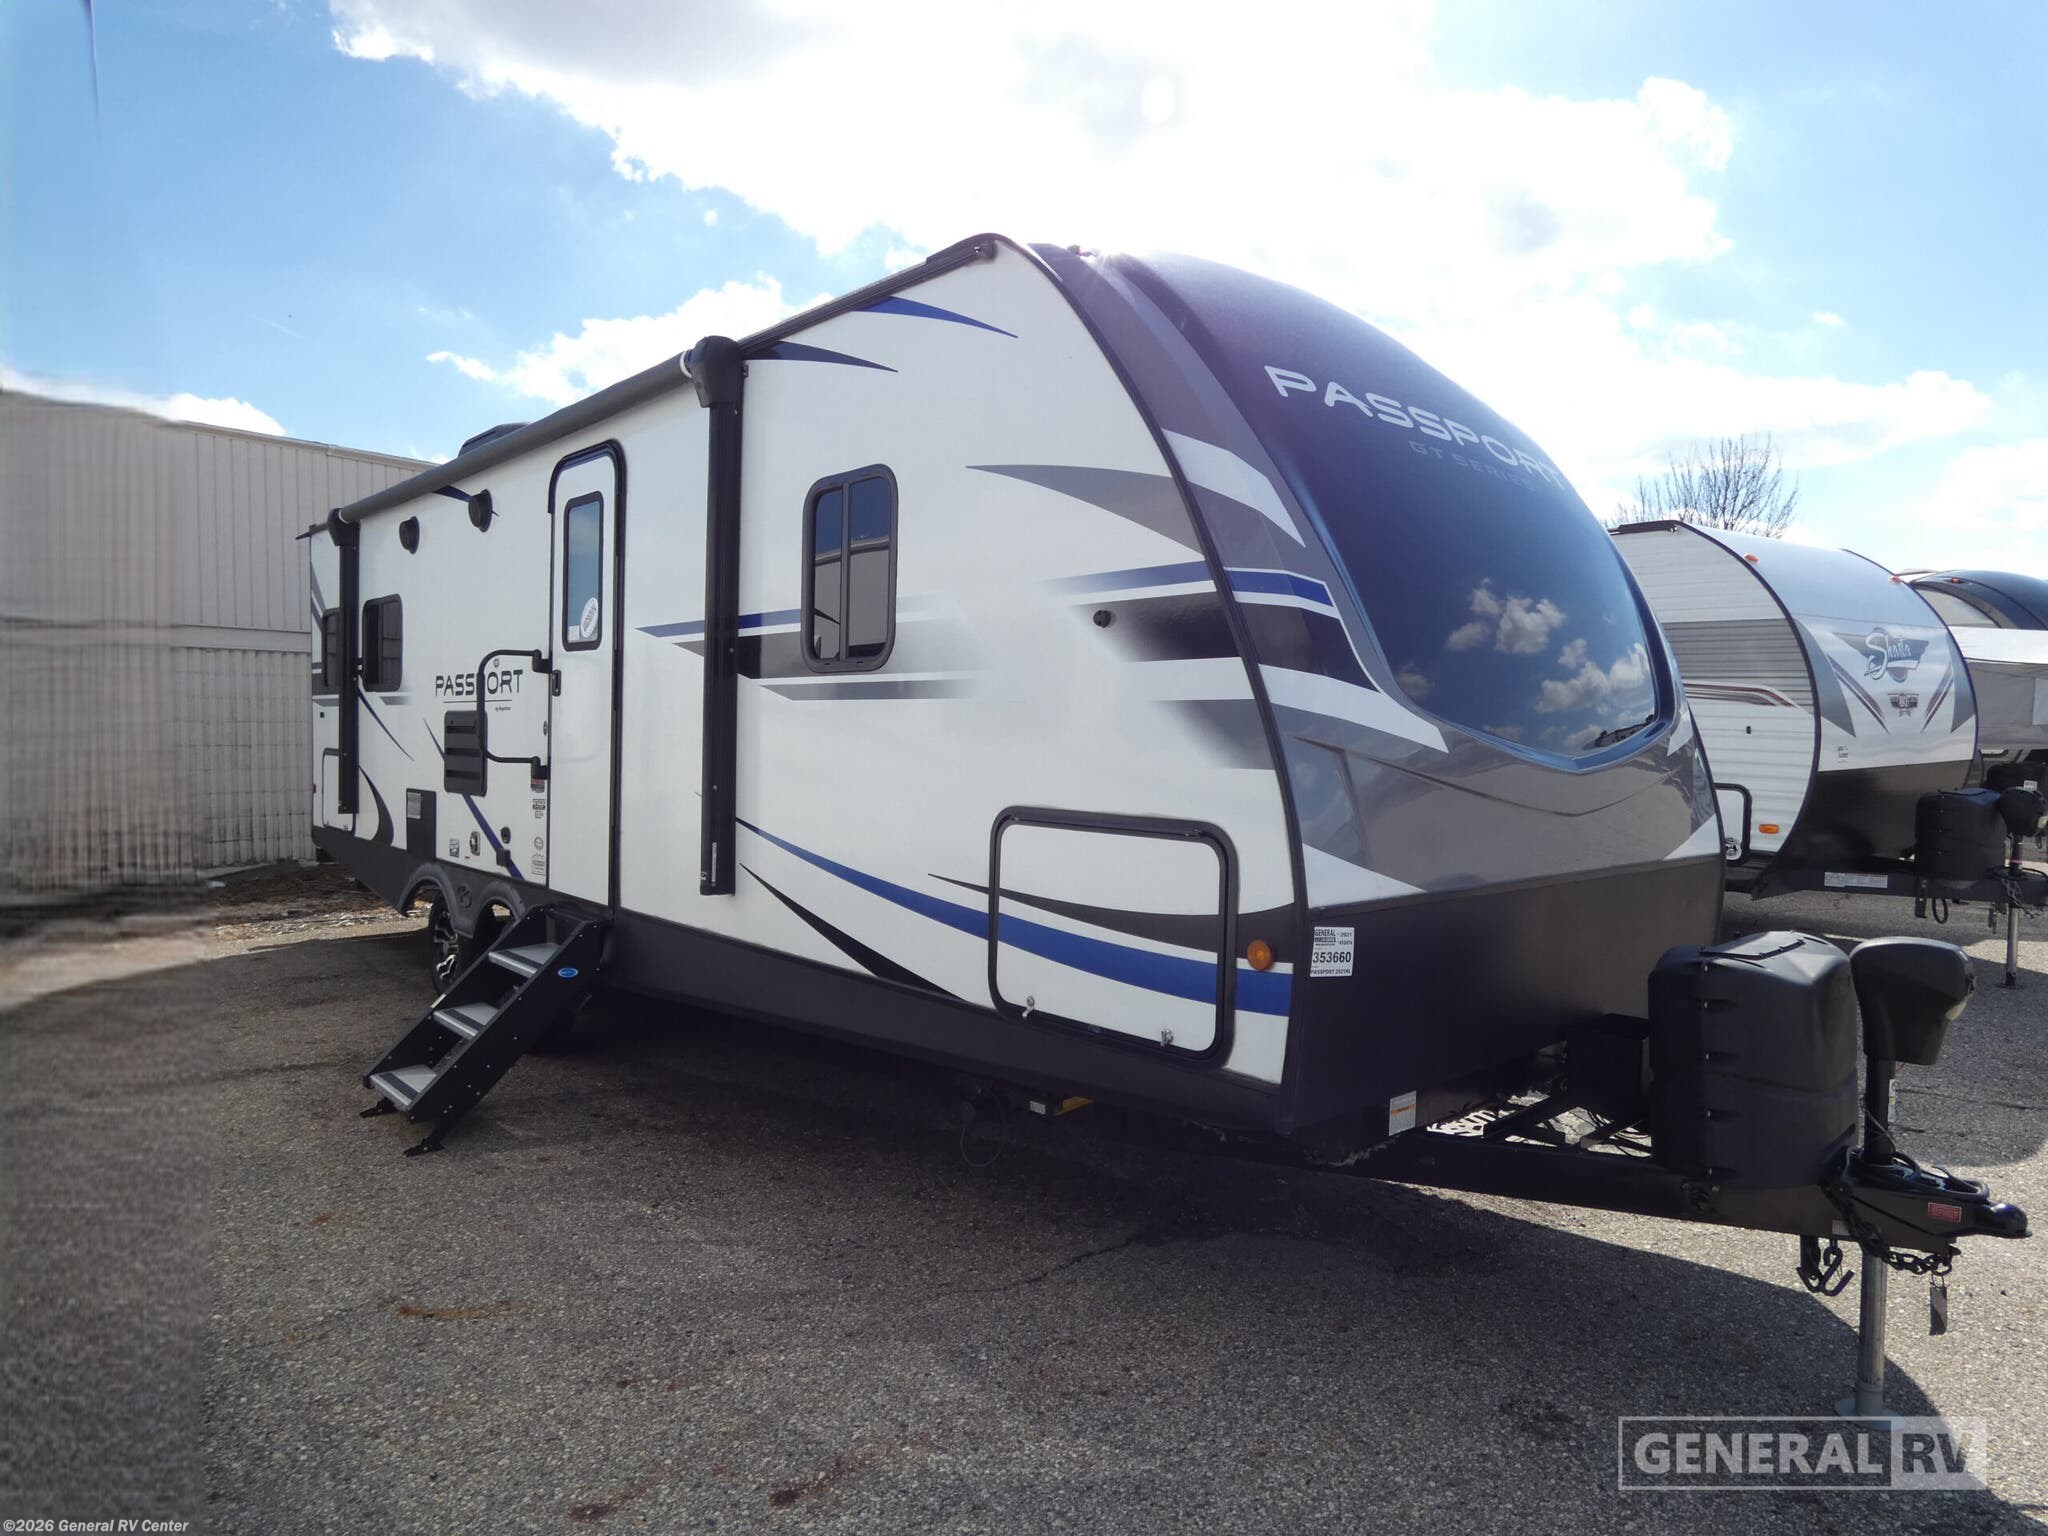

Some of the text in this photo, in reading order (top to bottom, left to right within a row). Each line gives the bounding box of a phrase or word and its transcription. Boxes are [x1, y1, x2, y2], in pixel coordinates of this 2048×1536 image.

[1263, 364, 1565, 490] PASSPORT
[435, 669, 523, 697] PASSORT
[1314, 928, 1336, 937] GENERAL
[1312, 951, 1352, 963] 353660
